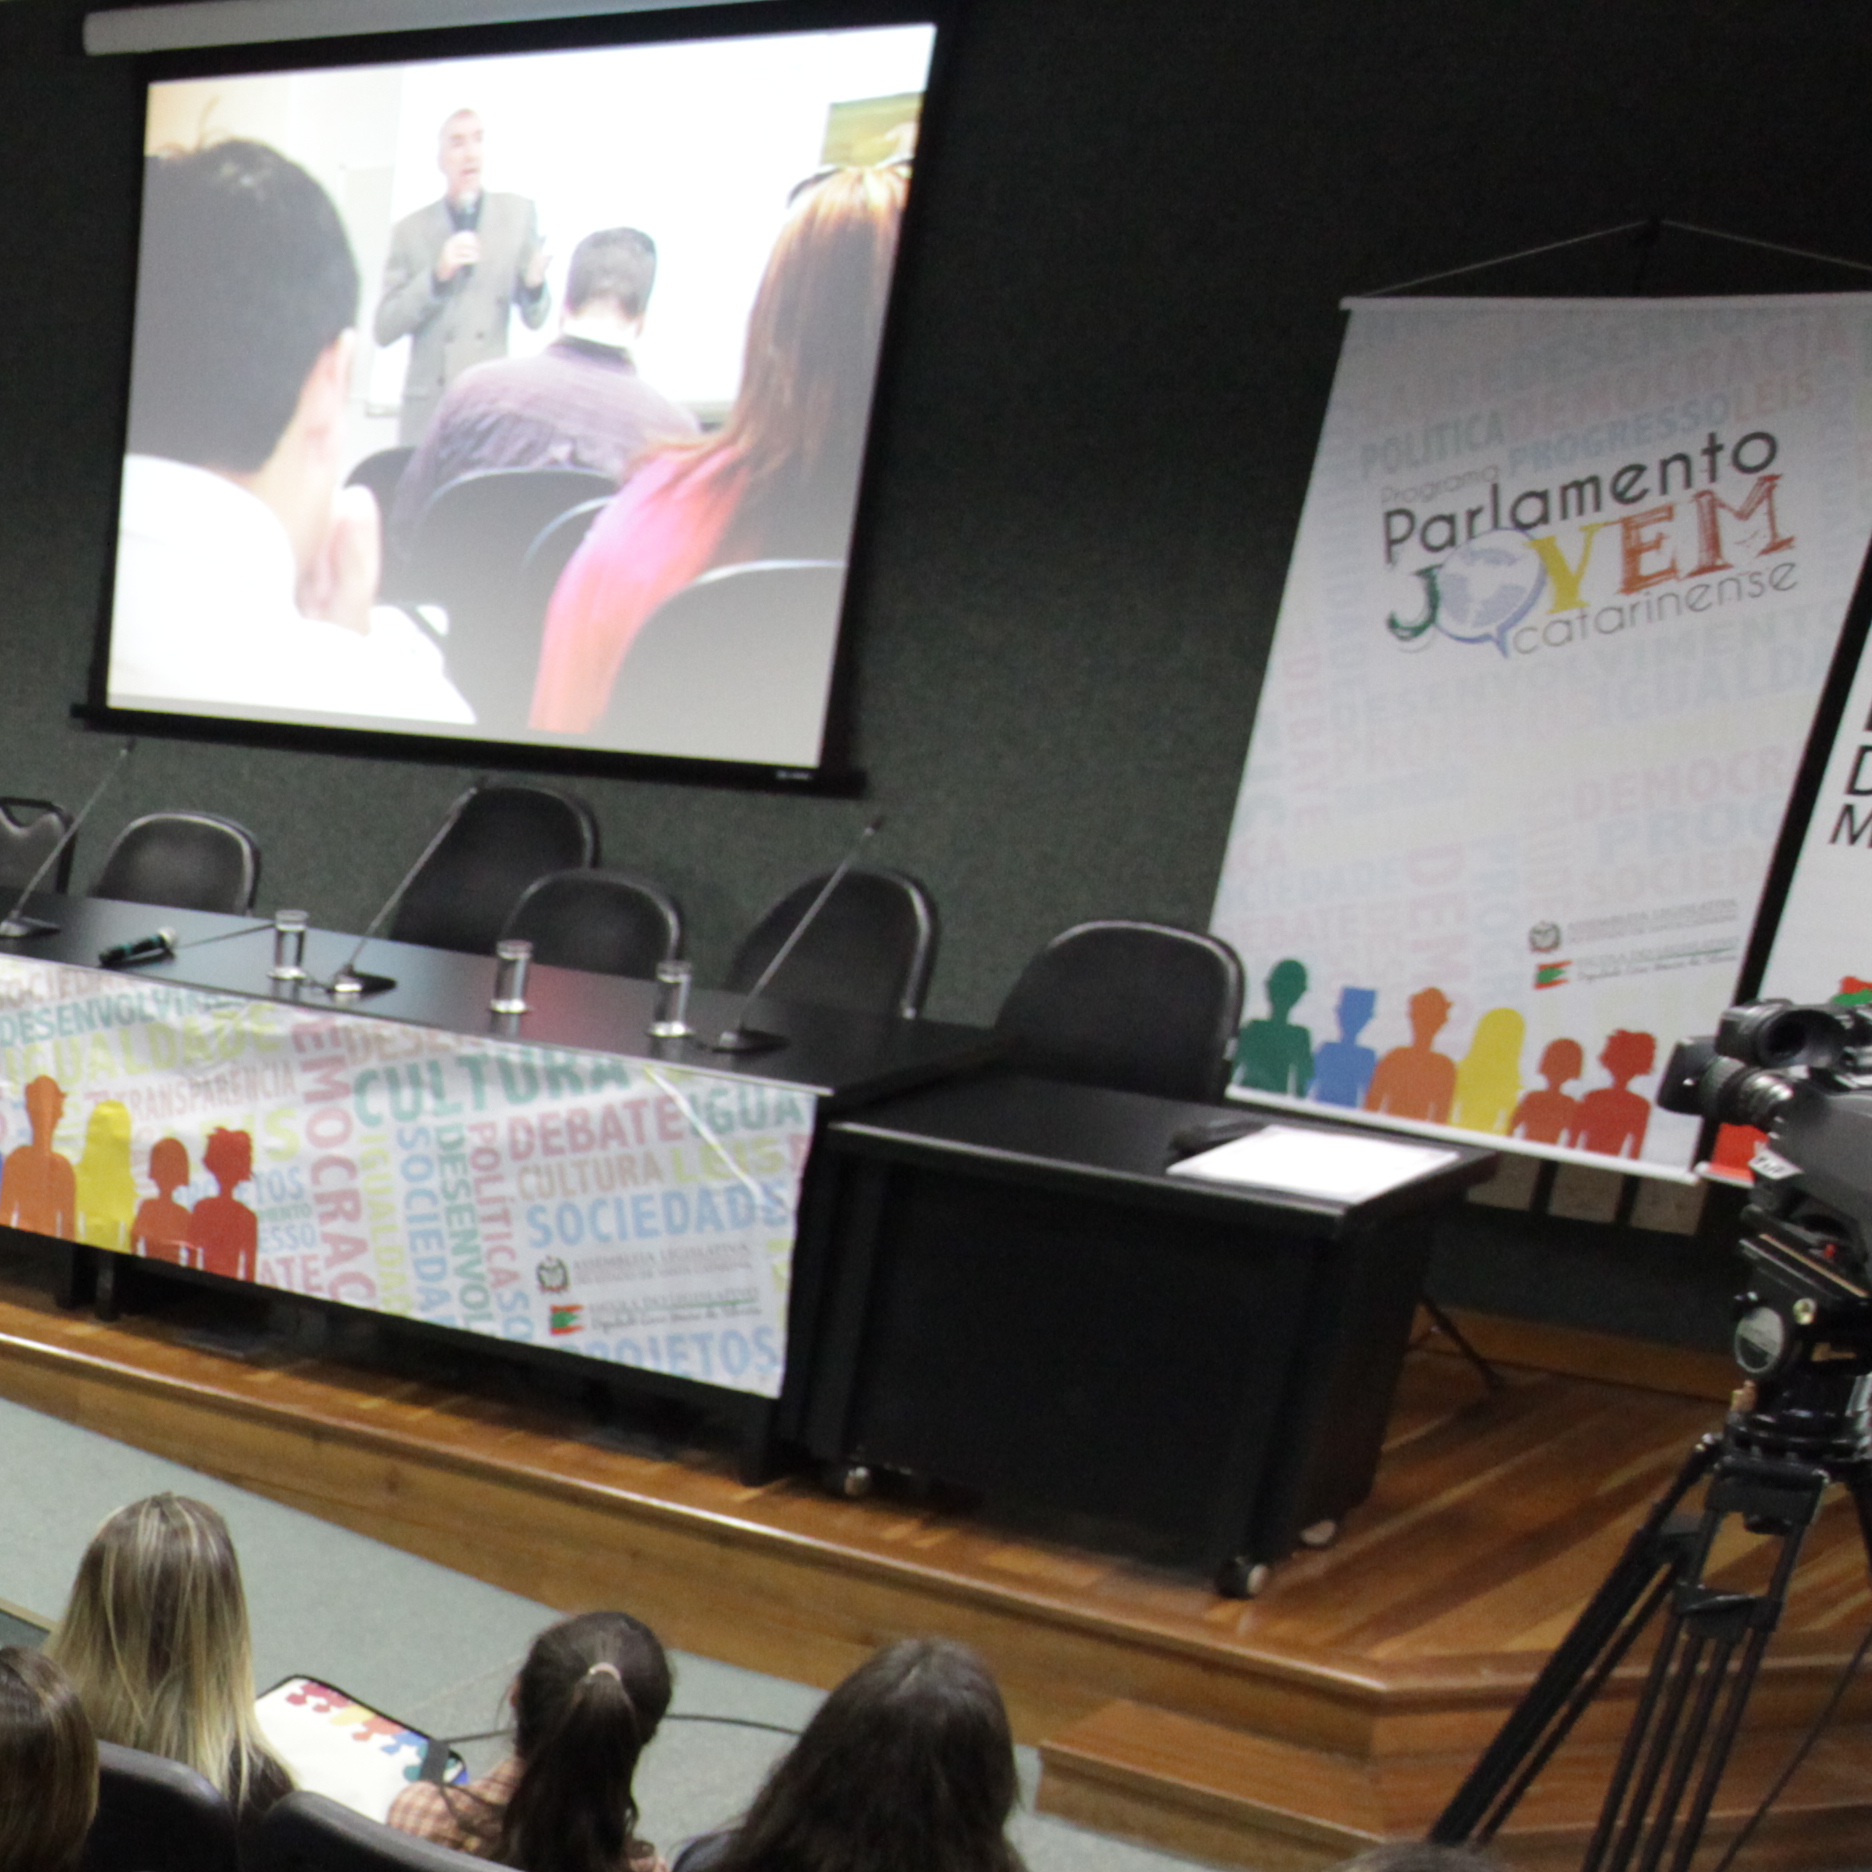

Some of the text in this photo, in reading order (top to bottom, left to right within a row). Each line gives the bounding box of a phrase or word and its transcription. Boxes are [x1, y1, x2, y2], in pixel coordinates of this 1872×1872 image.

[1382, 430, 1781, 567] Parlamento
[1513, 560, 1799, 658] catarinense
[352, 1052, 632, 1130] CULTURA
[506, 1094, 687, 1163] DEBATE
[467, 1121, 522, 1290] POLÍTICA
[517, 1152, 663, 1203] CULTURA
[672, 1136, 782, 1184] LEIS
[526, 1178, 789, 1250] SOCIEDADE
